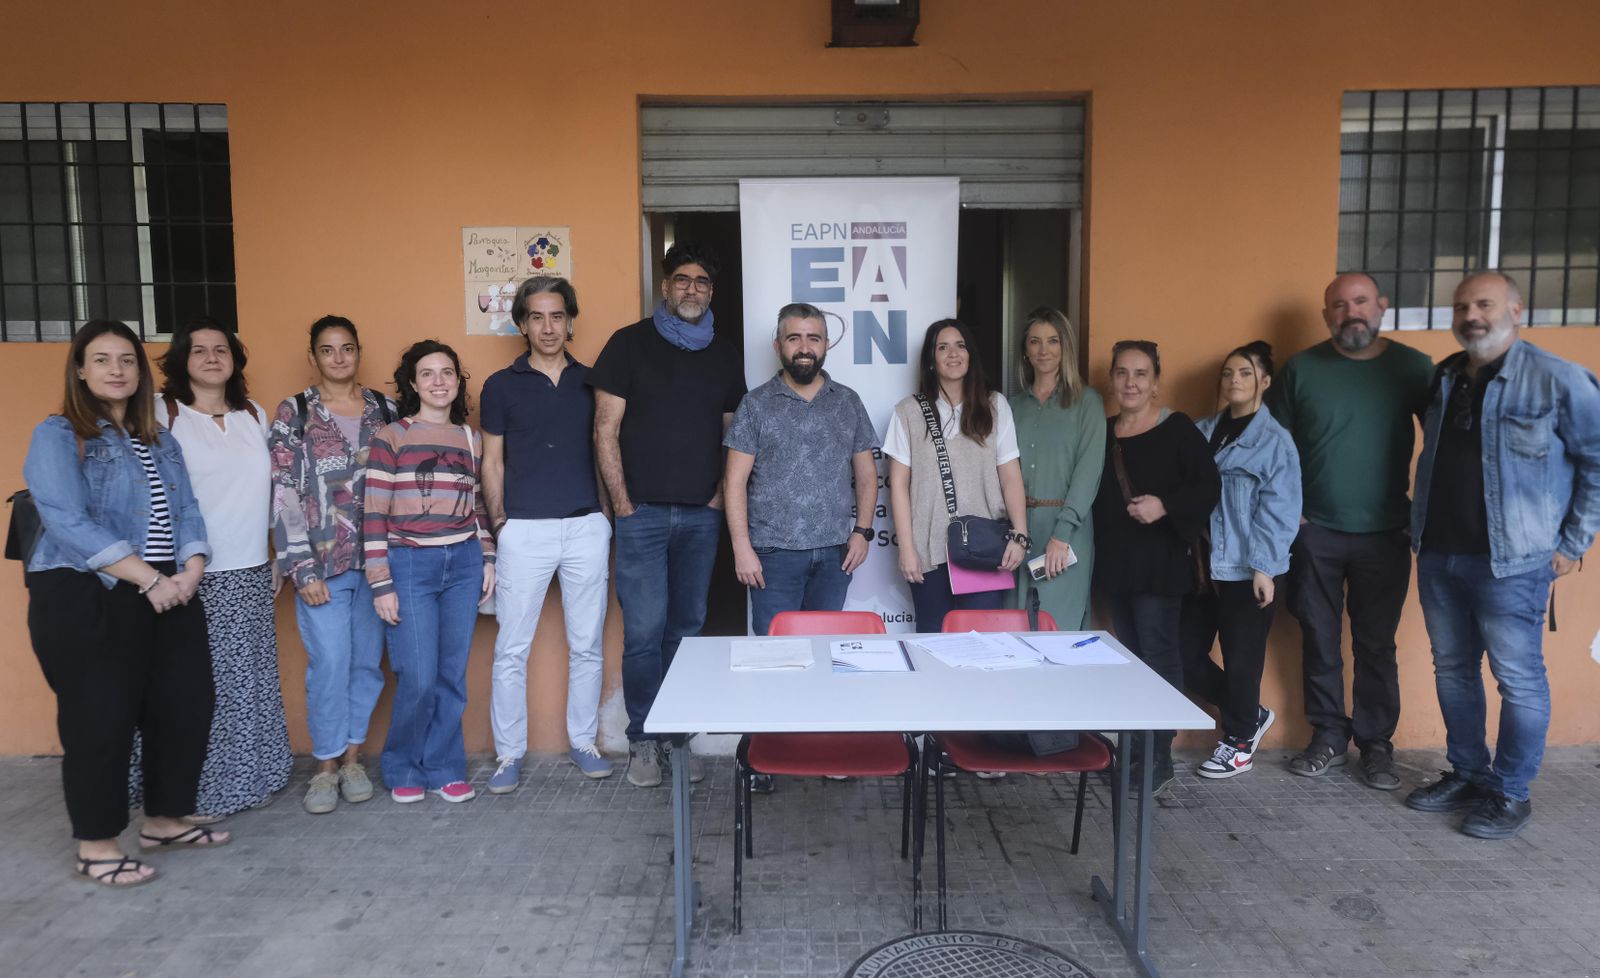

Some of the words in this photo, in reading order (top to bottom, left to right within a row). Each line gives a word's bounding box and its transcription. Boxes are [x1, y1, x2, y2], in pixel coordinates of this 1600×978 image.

[791, 222, 847, 241] EAPN
[852, 225, 906, 235] ANDALUCÍA
[468, 258, 515, 277] Margaritas
[920, 400, 941, 438] GETTING
[943, 479, 956, 496] MY
[855, 934, 975, 978] AYUNTAMIENTO
[995, 939, 1024, 951] DE
